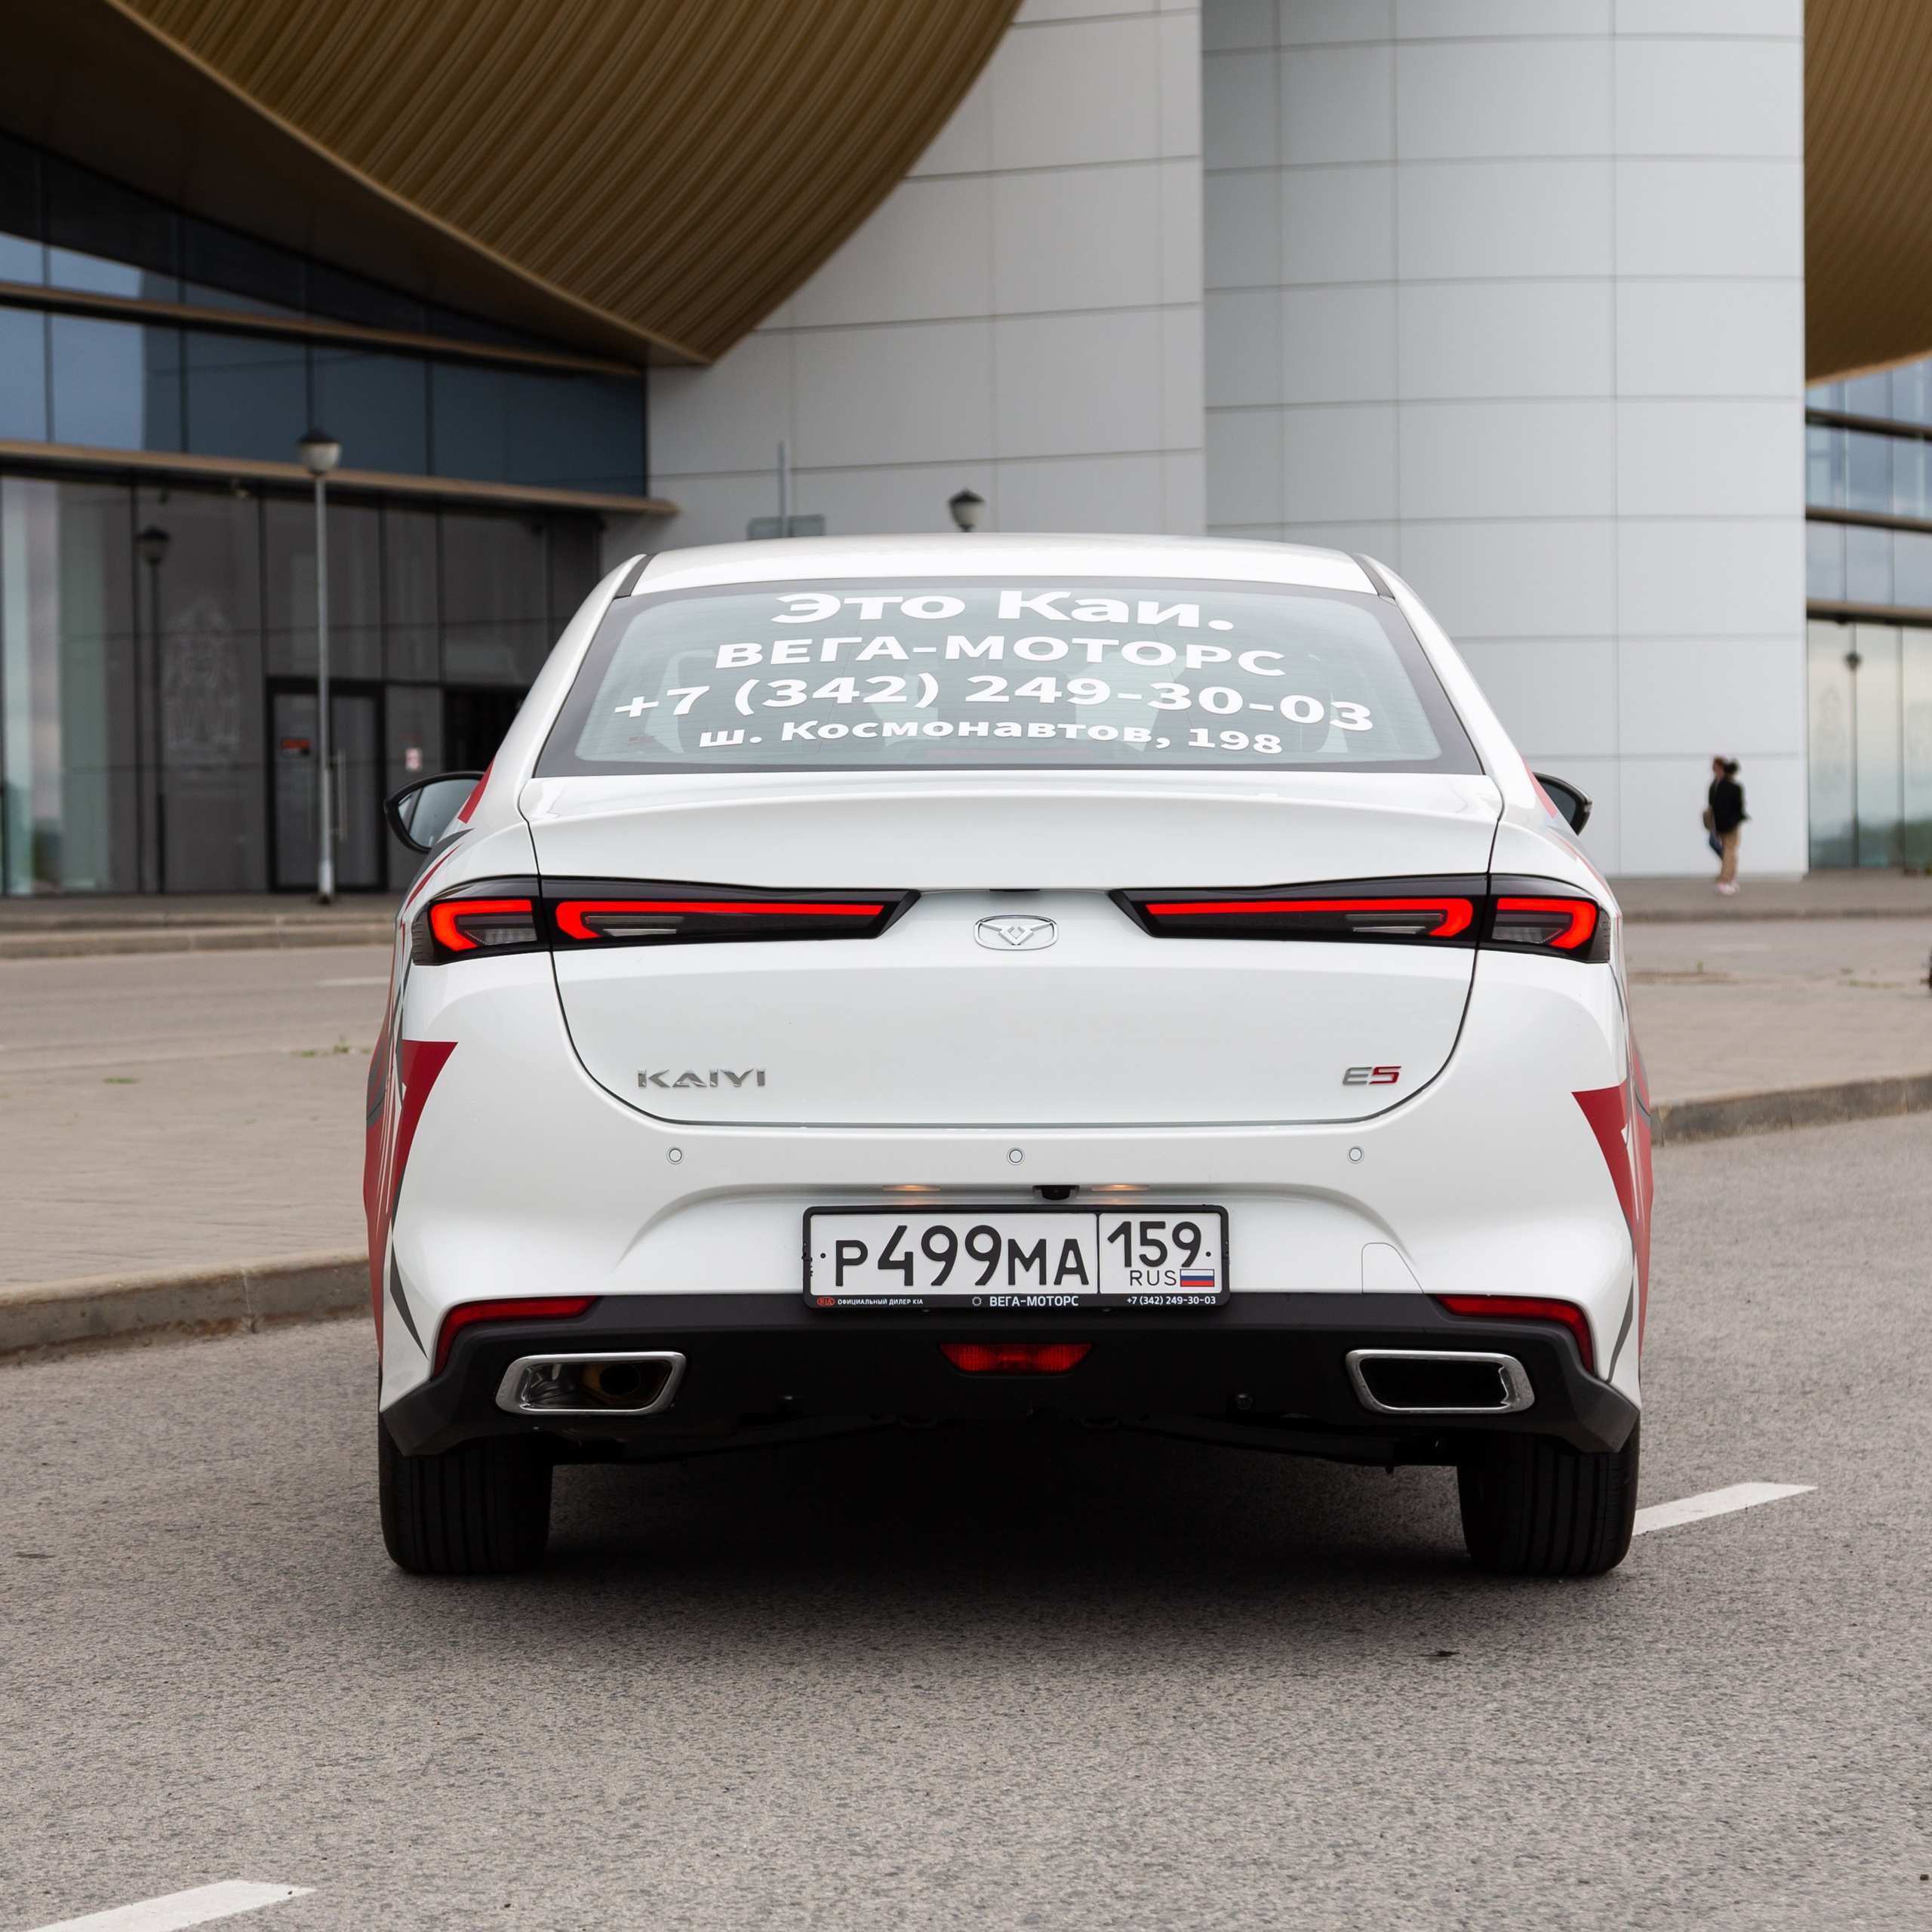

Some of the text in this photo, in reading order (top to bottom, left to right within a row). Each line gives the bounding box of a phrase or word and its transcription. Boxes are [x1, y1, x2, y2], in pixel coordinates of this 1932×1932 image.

[770, 589, 1235, 632] Это Каи.
[715, 635, 1287, 678] ВЕГА-МОТОРС
[614, 672, 1374, 732] +7 (342) 249-30-03
[698, 719, 1284, 755] ш. Космонавтов, 198
[637, 1067, 765, 1088] KAIYI
[1106, 1220, 1202, 1268] 159
[1129, 1269, 1177, 1287] RUS
[989, 1295, 1079, 1307] ВЕГА-МОТОРС
[1127, 1295, 1217, 1306] +7 (342) 249-30-03
